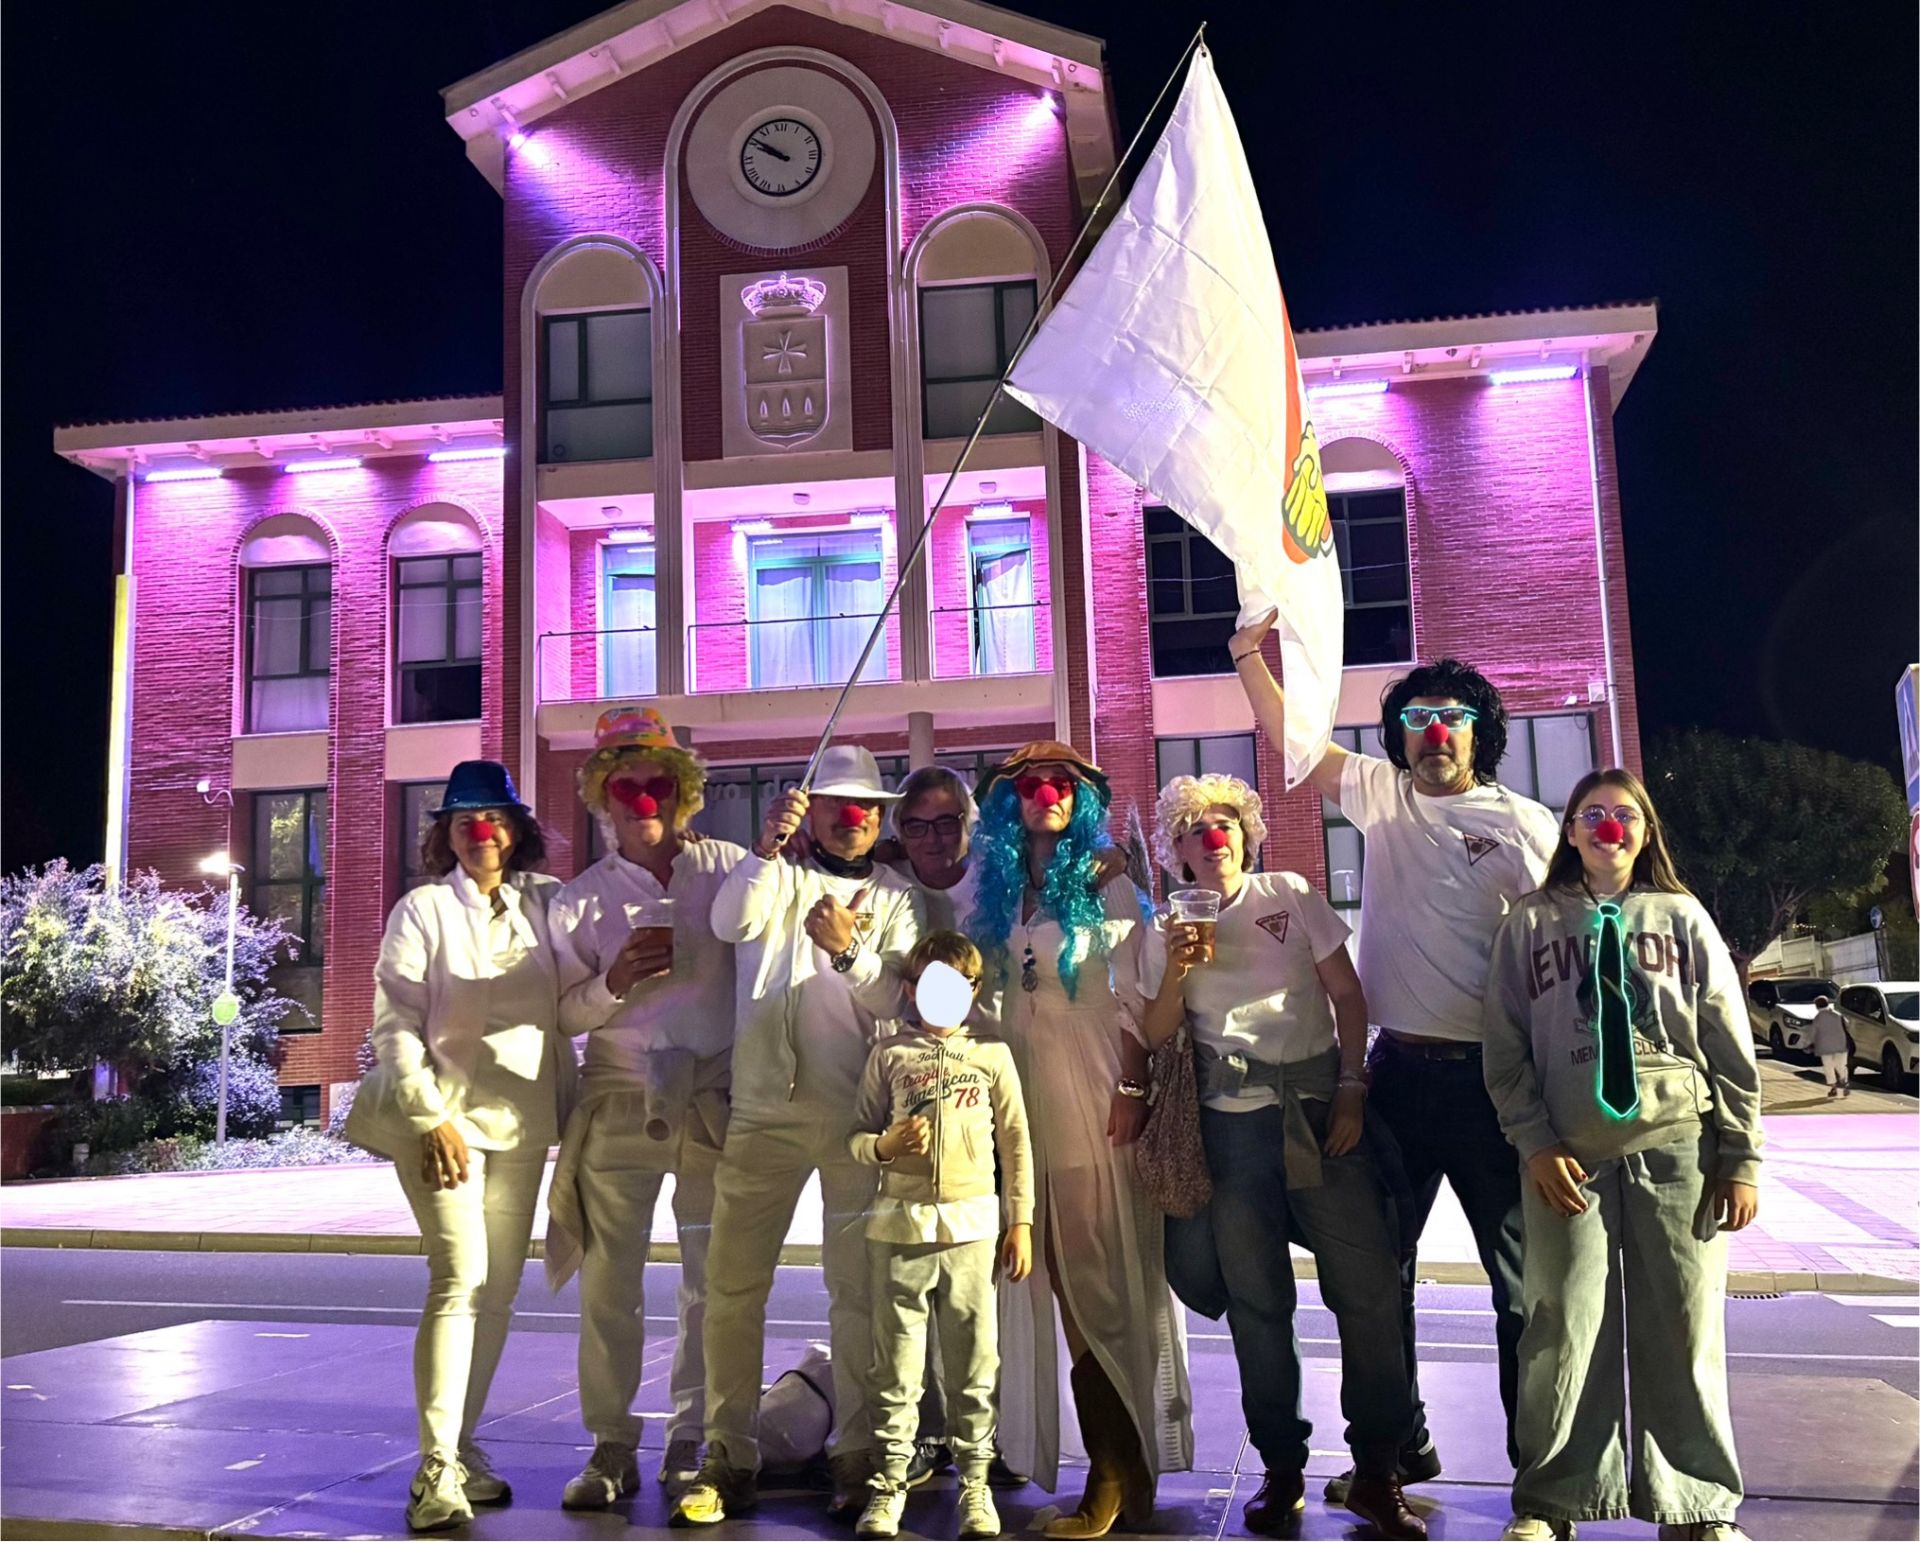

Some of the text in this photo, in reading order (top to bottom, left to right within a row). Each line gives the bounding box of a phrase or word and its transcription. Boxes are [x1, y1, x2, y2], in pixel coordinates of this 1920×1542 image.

[1621, 931, 1697, 986] OR
[916, 1045, 964, 1064] Fooall
[1570, 1045, 1597, 1066] MEN
[954, 1086, 980, 1109] 78
